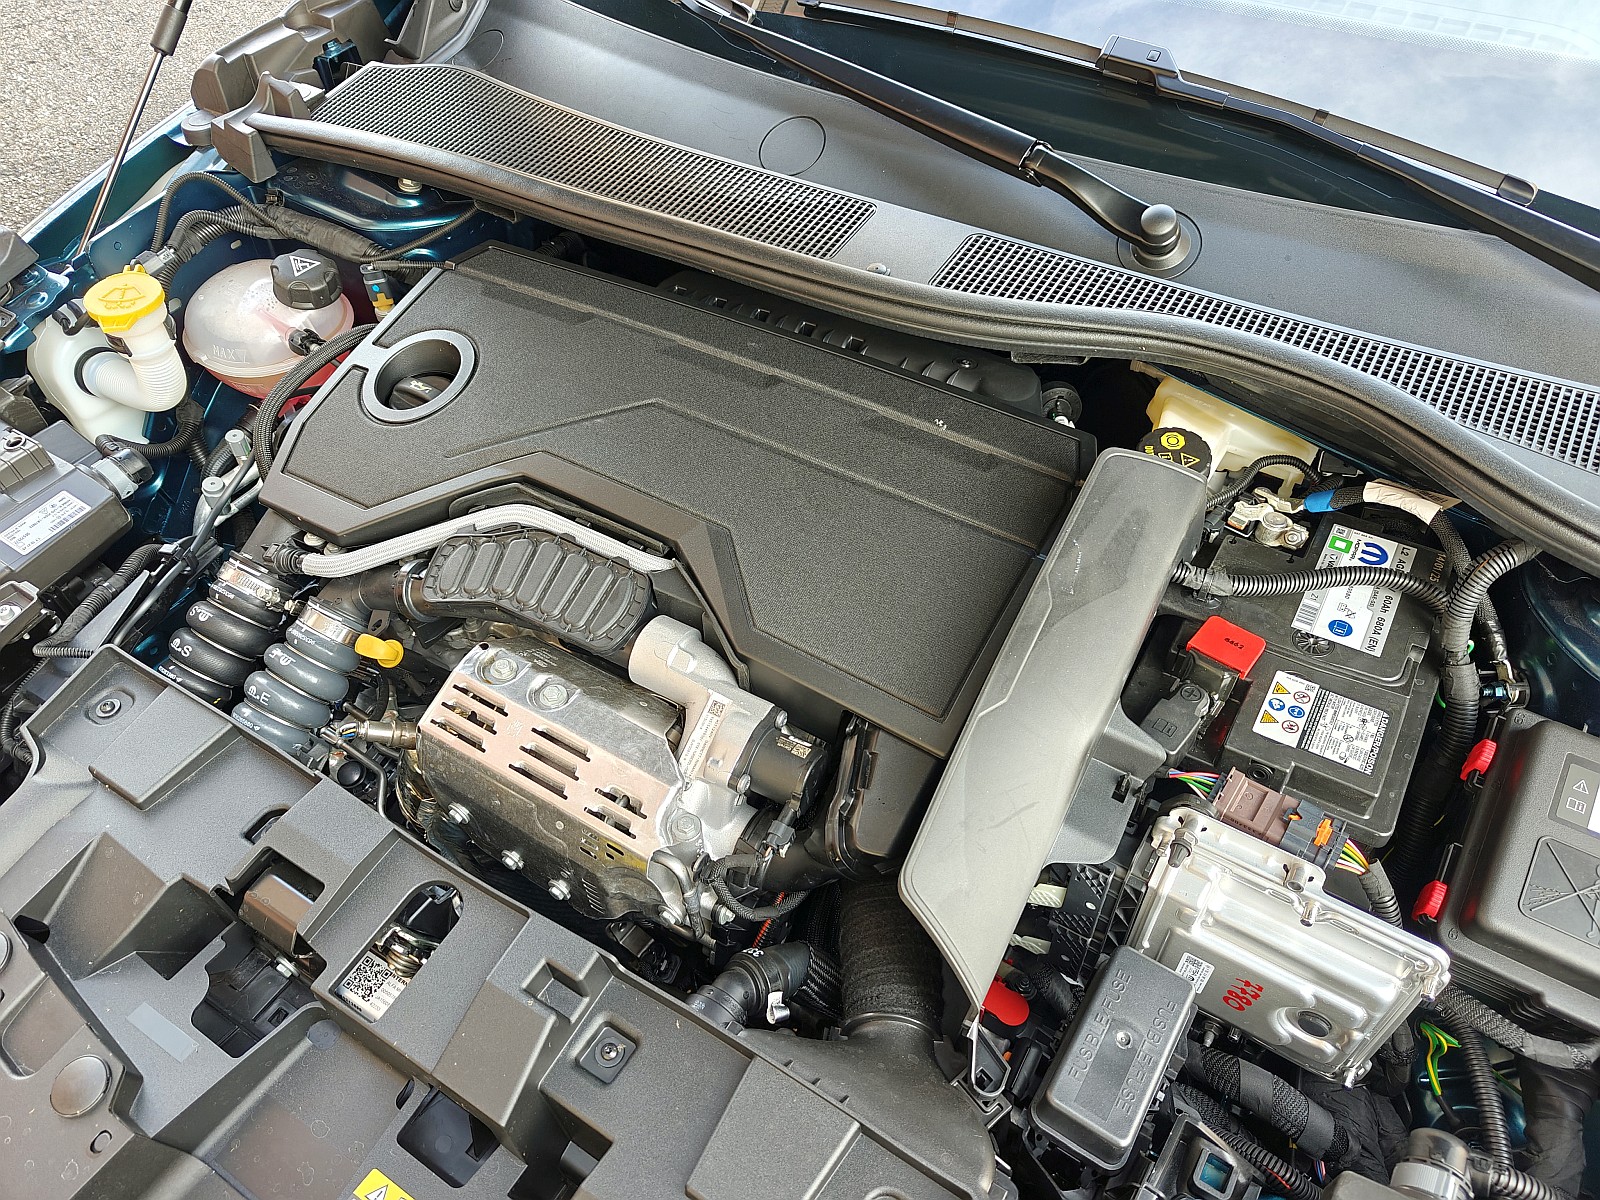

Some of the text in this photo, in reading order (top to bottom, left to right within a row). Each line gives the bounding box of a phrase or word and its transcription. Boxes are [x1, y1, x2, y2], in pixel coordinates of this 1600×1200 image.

[212, 344, 236, 360] MAX
[1400, 546, 1411, 557] L2
[1395, 558, 1407, 573] AG
[1429, 553, 1446, 583] 14/01/25
[1379, 595, 1393, 614] 60Ah
[1371, 616, 1386, 635] 680A
[1364, 637, 1379, 653] (EN)
[1363, 716, 1389, 775] DANGER/POISON
[1067, 969, 1132, 1082] FUSIBLE/FUSE
[1115, 997, 1179, 1115] FUSIBLE/FUSE
